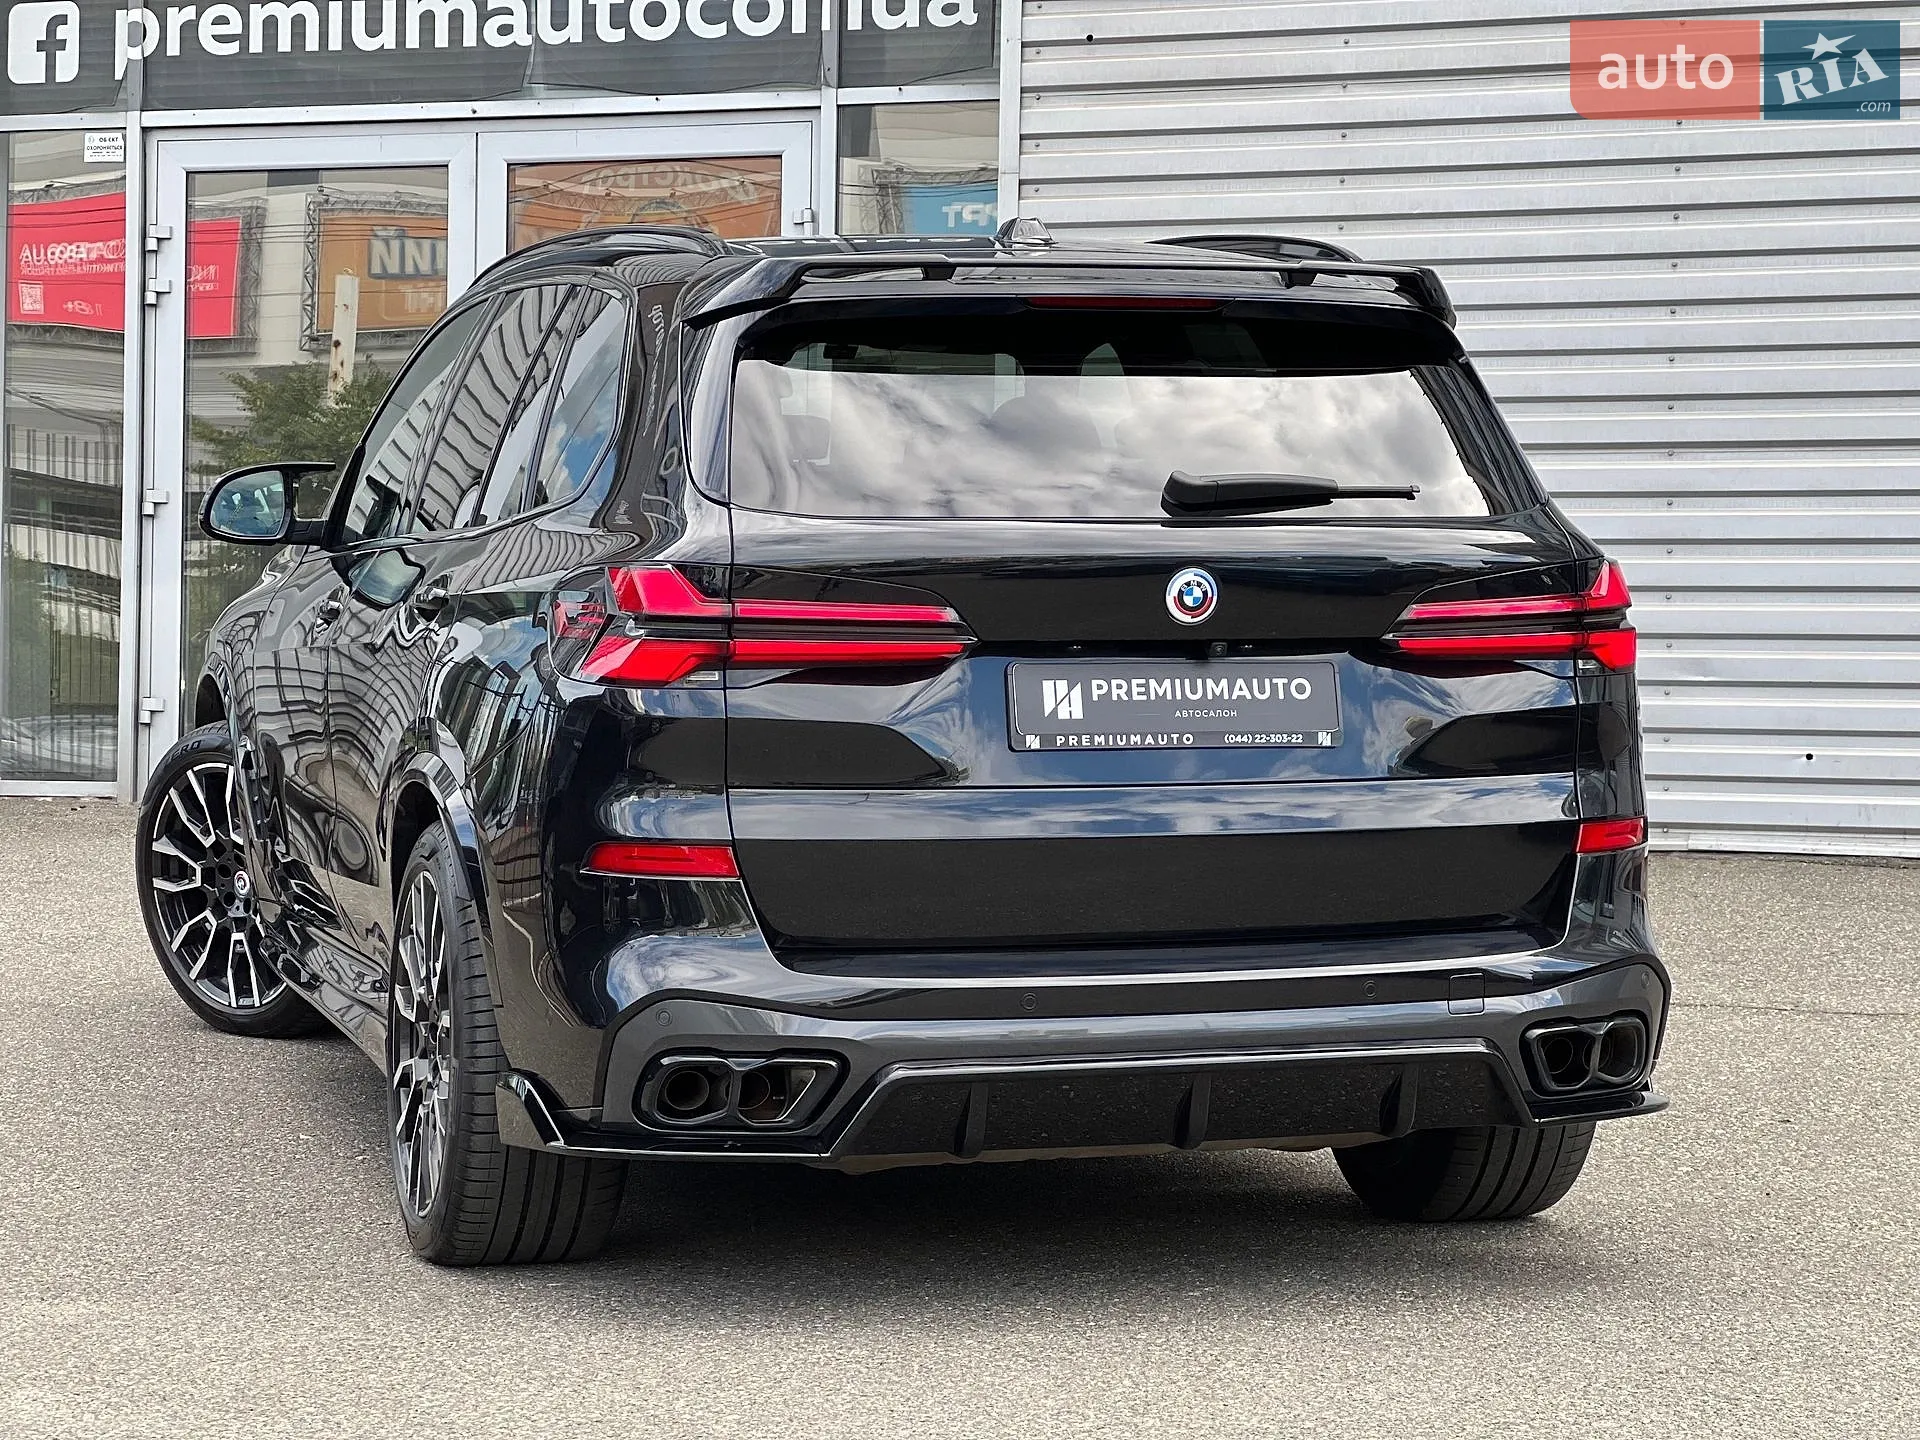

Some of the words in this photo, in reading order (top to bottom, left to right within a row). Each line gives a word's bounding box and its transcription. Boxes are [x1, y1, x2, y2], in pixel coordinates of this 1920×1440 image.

[1180, 579, 1207, 592] BMW
[1091, 677, 1312, 702] PREMIUMAUTO
[1174, 709, 1238, 719] АВТОСАЛОН
[1056, 733, 1194, 747] PREMIUMAUTO
[1224, 733, 1253, 744] (044)
[1254, 733, 1304, 744] 22-303-22
